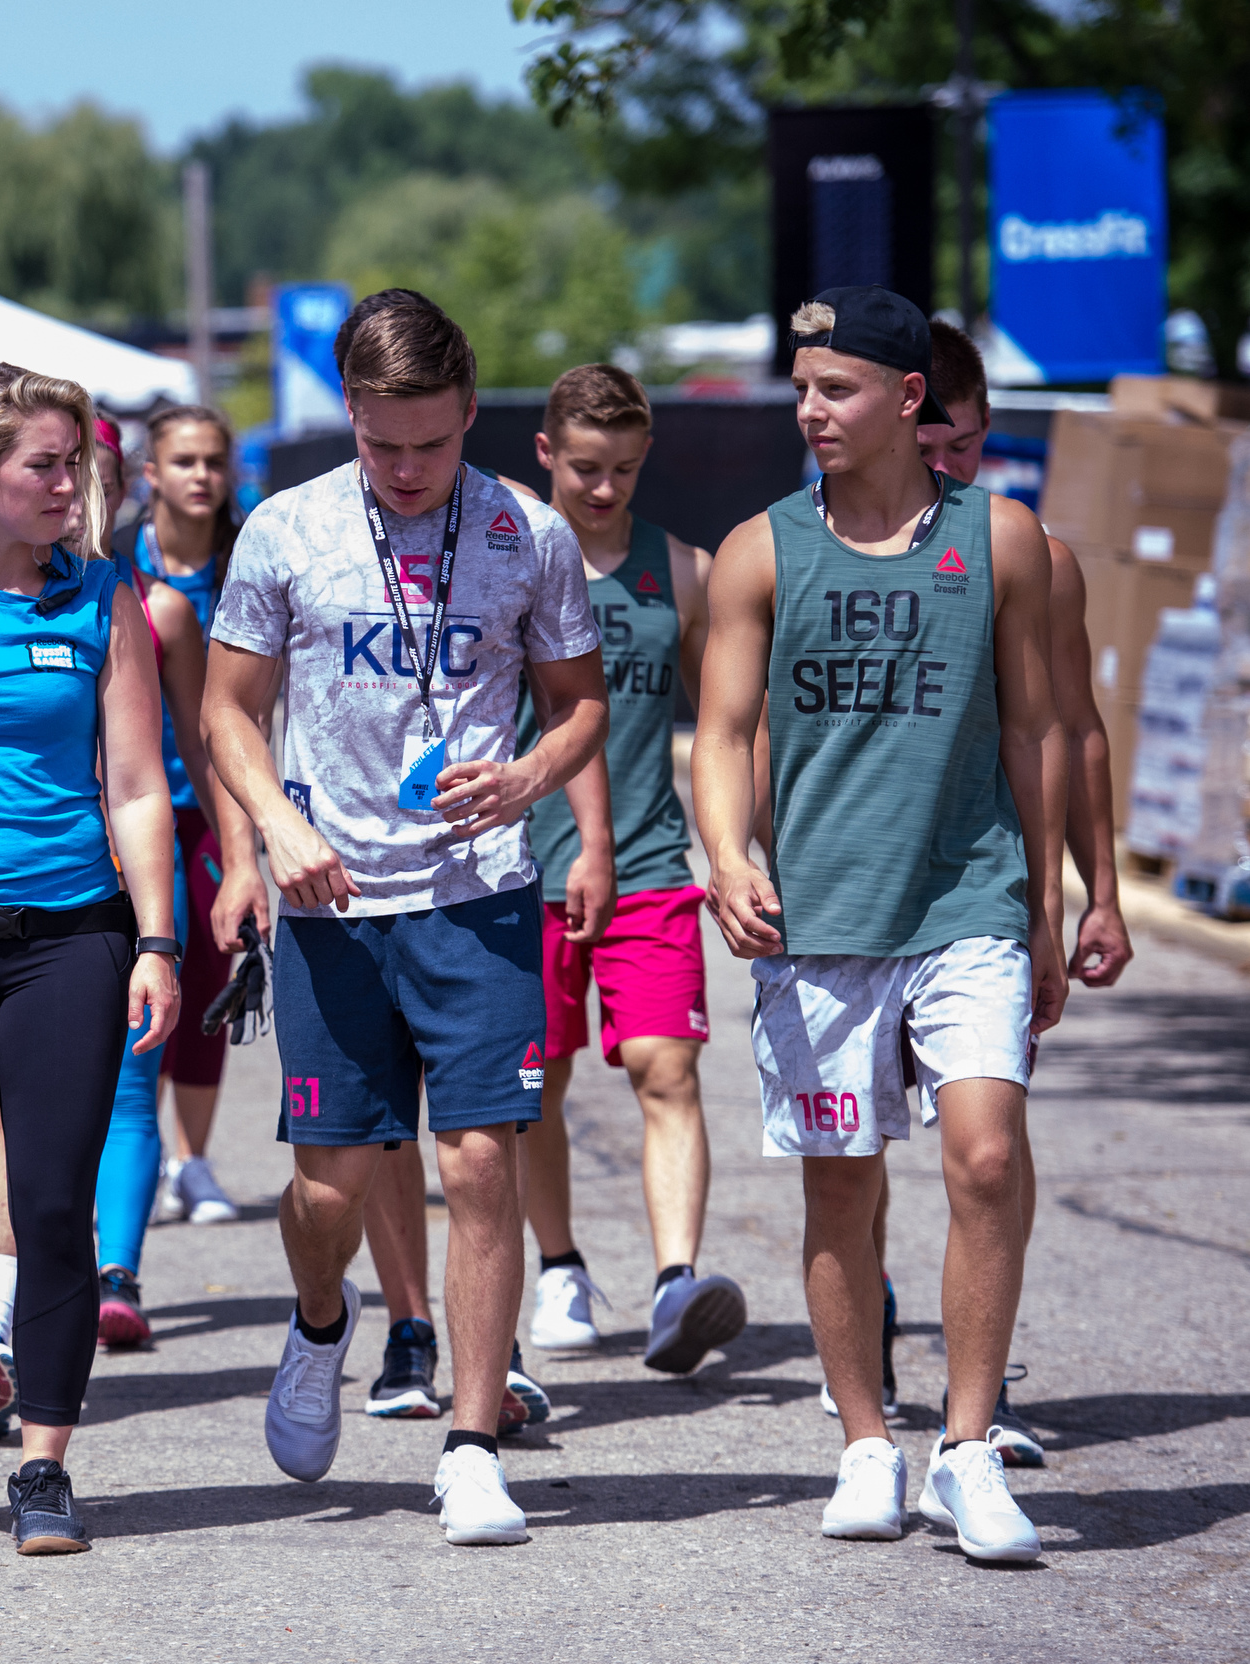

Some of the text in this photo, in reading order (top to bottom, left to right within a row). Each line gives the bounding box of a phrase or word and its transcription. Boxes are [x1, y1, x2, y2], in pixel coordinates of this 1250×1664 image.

[1000, 210, 1147, 261] CrossFit
[369, 506, 386, 540] CrossFit
[485, 530, 522, 543] Reebok
[488, 541, 519, 553] CrossFit
[440, 550, 453, 584] CrossFit
[931, 571, 970, 584] Reebok
[383, 557, 409, 630] FORGING ELITE FITNESS
[933, 583, 967, 595] CrossFit
[436, 601, 444, 631] FORGING
[823, 590, 920, 642] 160
[31, 645, 71, 658] CrossFit
[32, 657, 73, 669] GAMES
[343, 622, 483, 677] KUC
[409, 647, 424, 680] CrossFit
[426, 648, 436, 676] FITNESS
[340, 681, 396, 690] CROSSFIT
[445, 681, 478, 691] BLOOD
[792, 658, 948, 717] SEELE
[409, 743, 436, 774] ATHLETE
[285, 1076, 320, 1117] 51
[795, 1092, 860, 1132] 160
